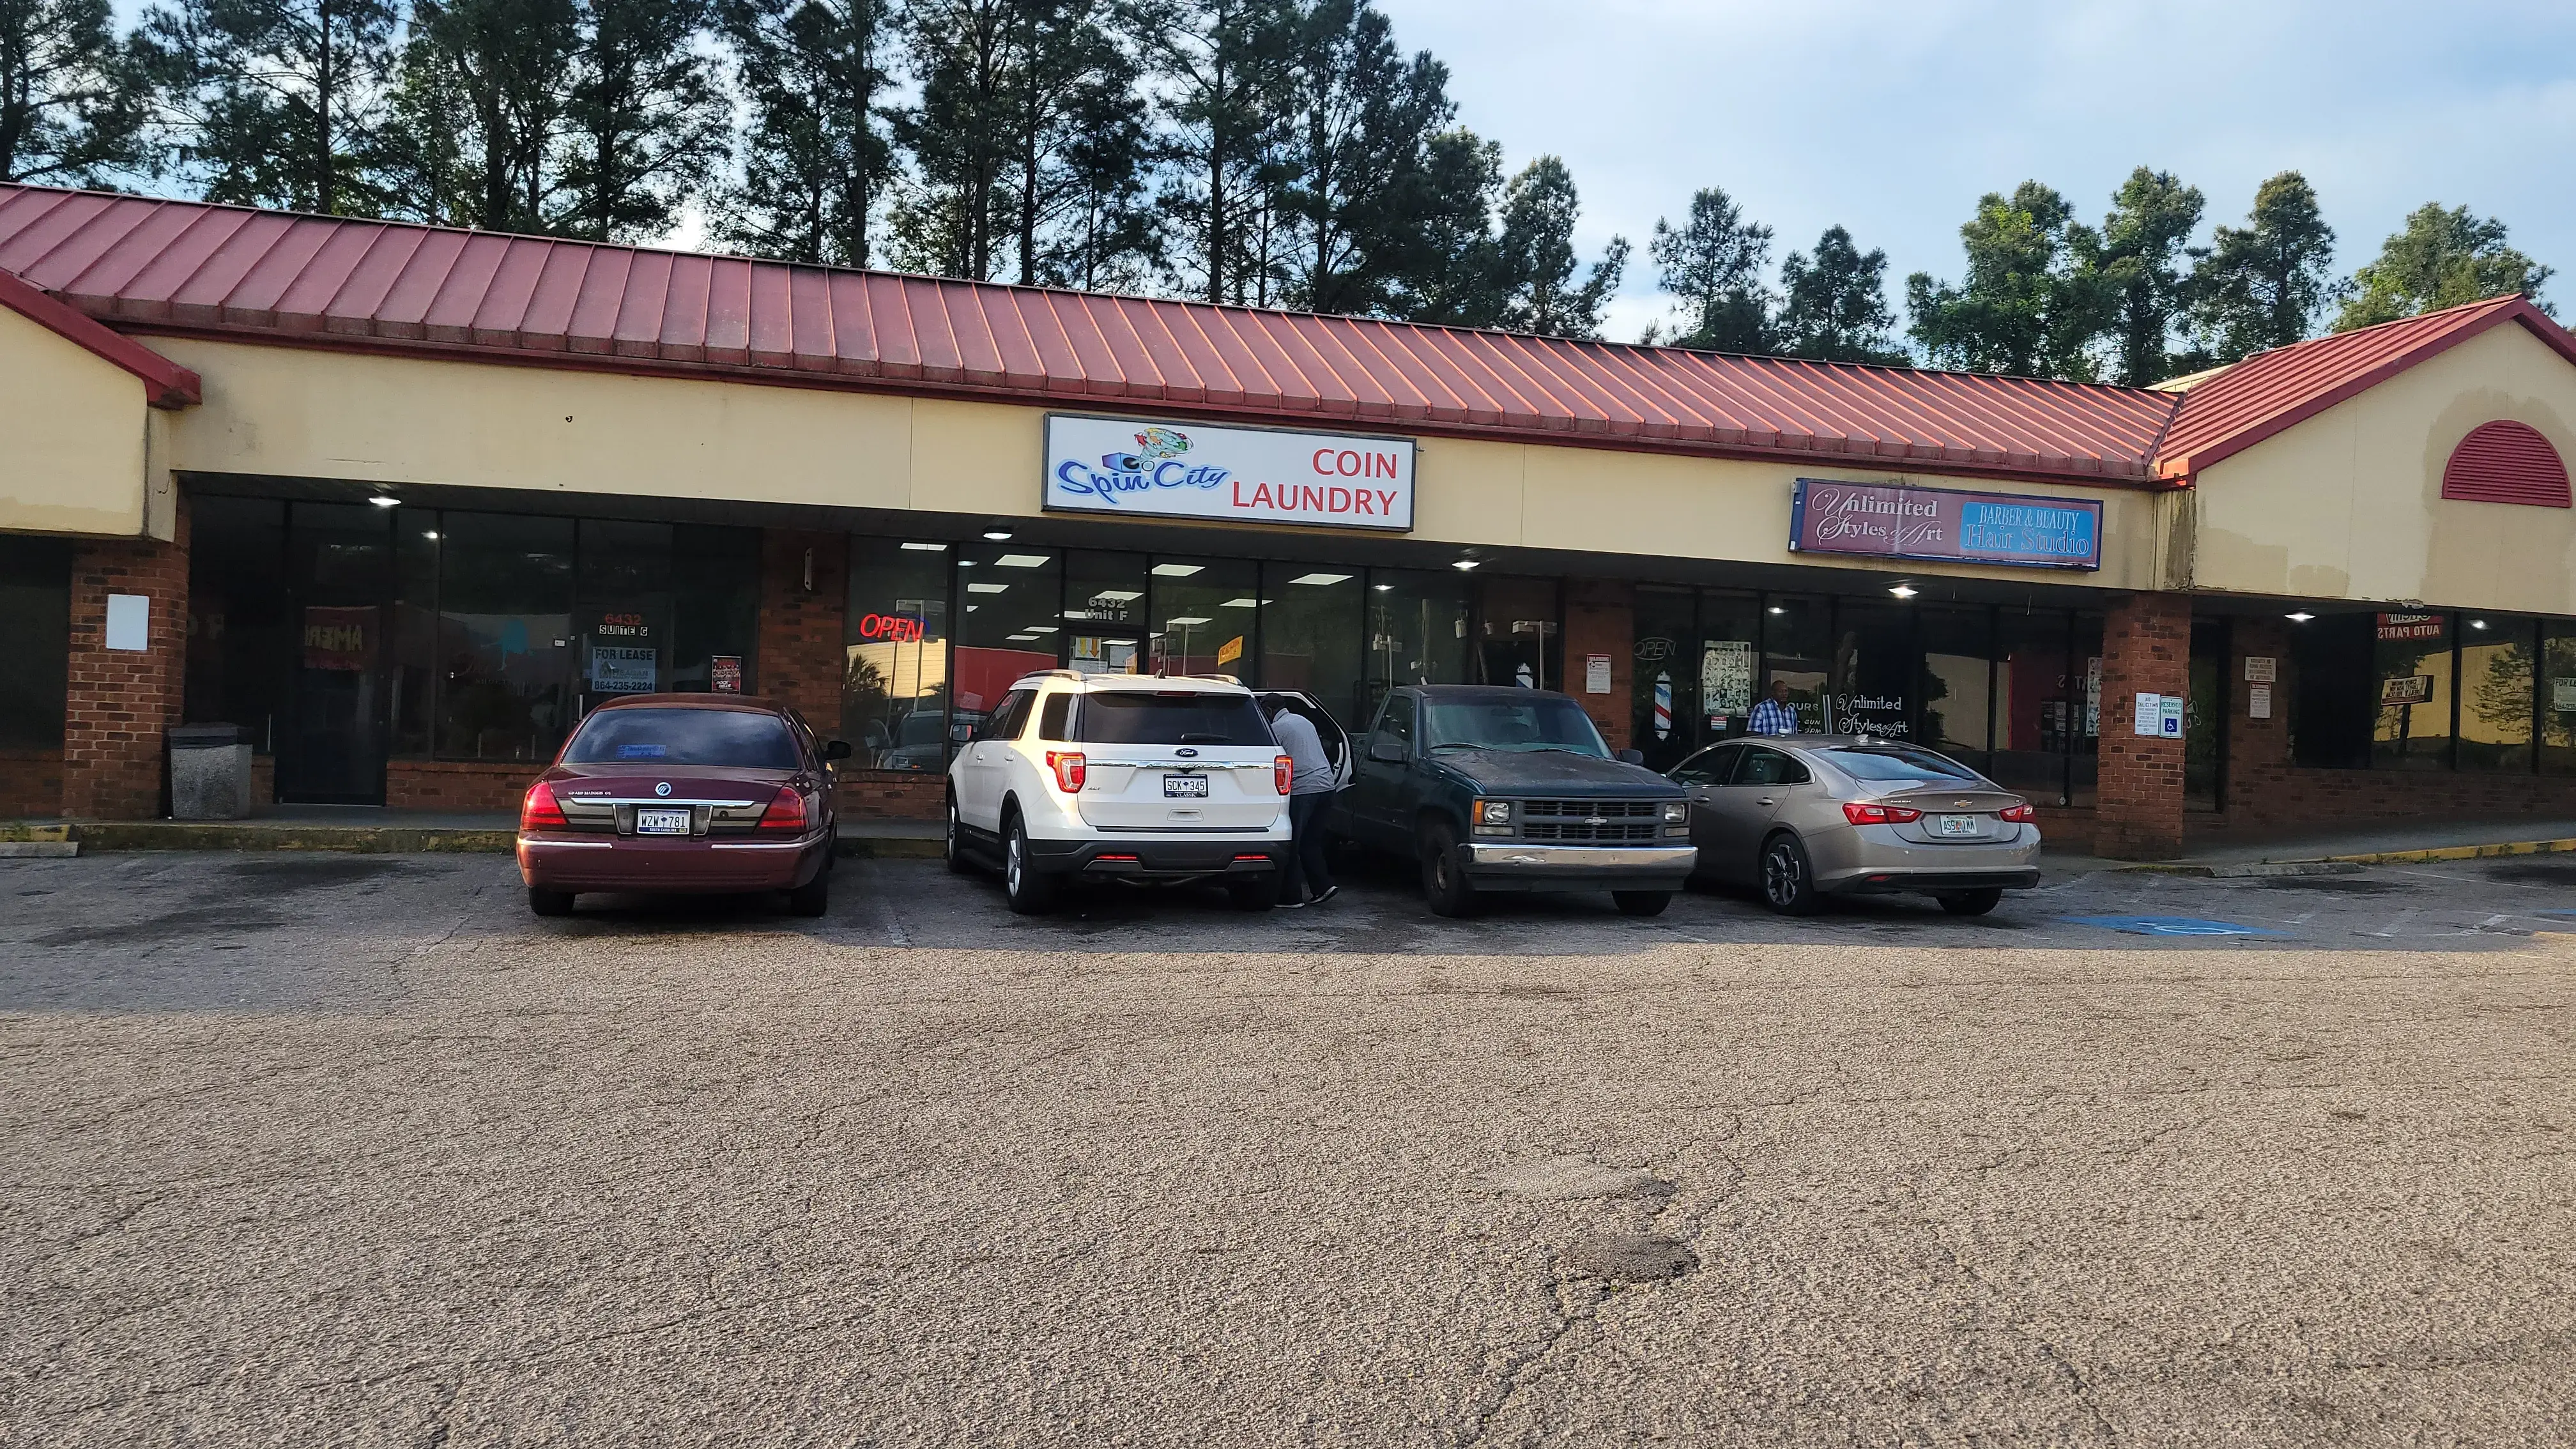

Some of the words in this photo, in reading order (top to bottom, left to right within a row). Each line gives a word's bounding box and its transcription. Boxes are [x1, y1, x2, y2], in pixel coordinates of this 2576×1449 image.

[1312, 448, 1397, 479] COIN
[1058, 461, 1149, 505] Spin
[1154, 461, 1228, 487] City
[1232, 481, 1397, 516] LAUNDRY
[1812, 488, 1938, 519] Unlimited
[1979, 505, 2022, 526] BARBER
[2025, 509, 2034, 527] &
[2036, 509, 2080, 531] BEAUTY
[1816, 514, 1887, 545] Styles
[1965, 524, 2014, 549] Hair
[2021, 528, 2089, 555] Studio
[1088, 597, 1125, 608] 6432
[605, 613, 641, 625] 6432
[1085, 609, 1113, 620] Unit
[1119, 610, 1128, 621] F
[600, 625, 635, 635] SUITE
[640, 627, 648, 636] G
[860, 613, 924, 643] OPEN
[595, 648, 617, 659] FOR
[619, 649, 653, 661] LEASE
[1634, 641, 1676, 656] OPEN
[594, 680, 652, 691] 864-235-2224
[1836, 693, 1902, 716] Unlimited
[1839, 713, 1882, 733] Styles
[1167, 780, 1182, 791] SCK
[1190, 781, 1205, 791] 345
[641, 815, 658, 827] WZW
[669, 816, 686, 827] 781
